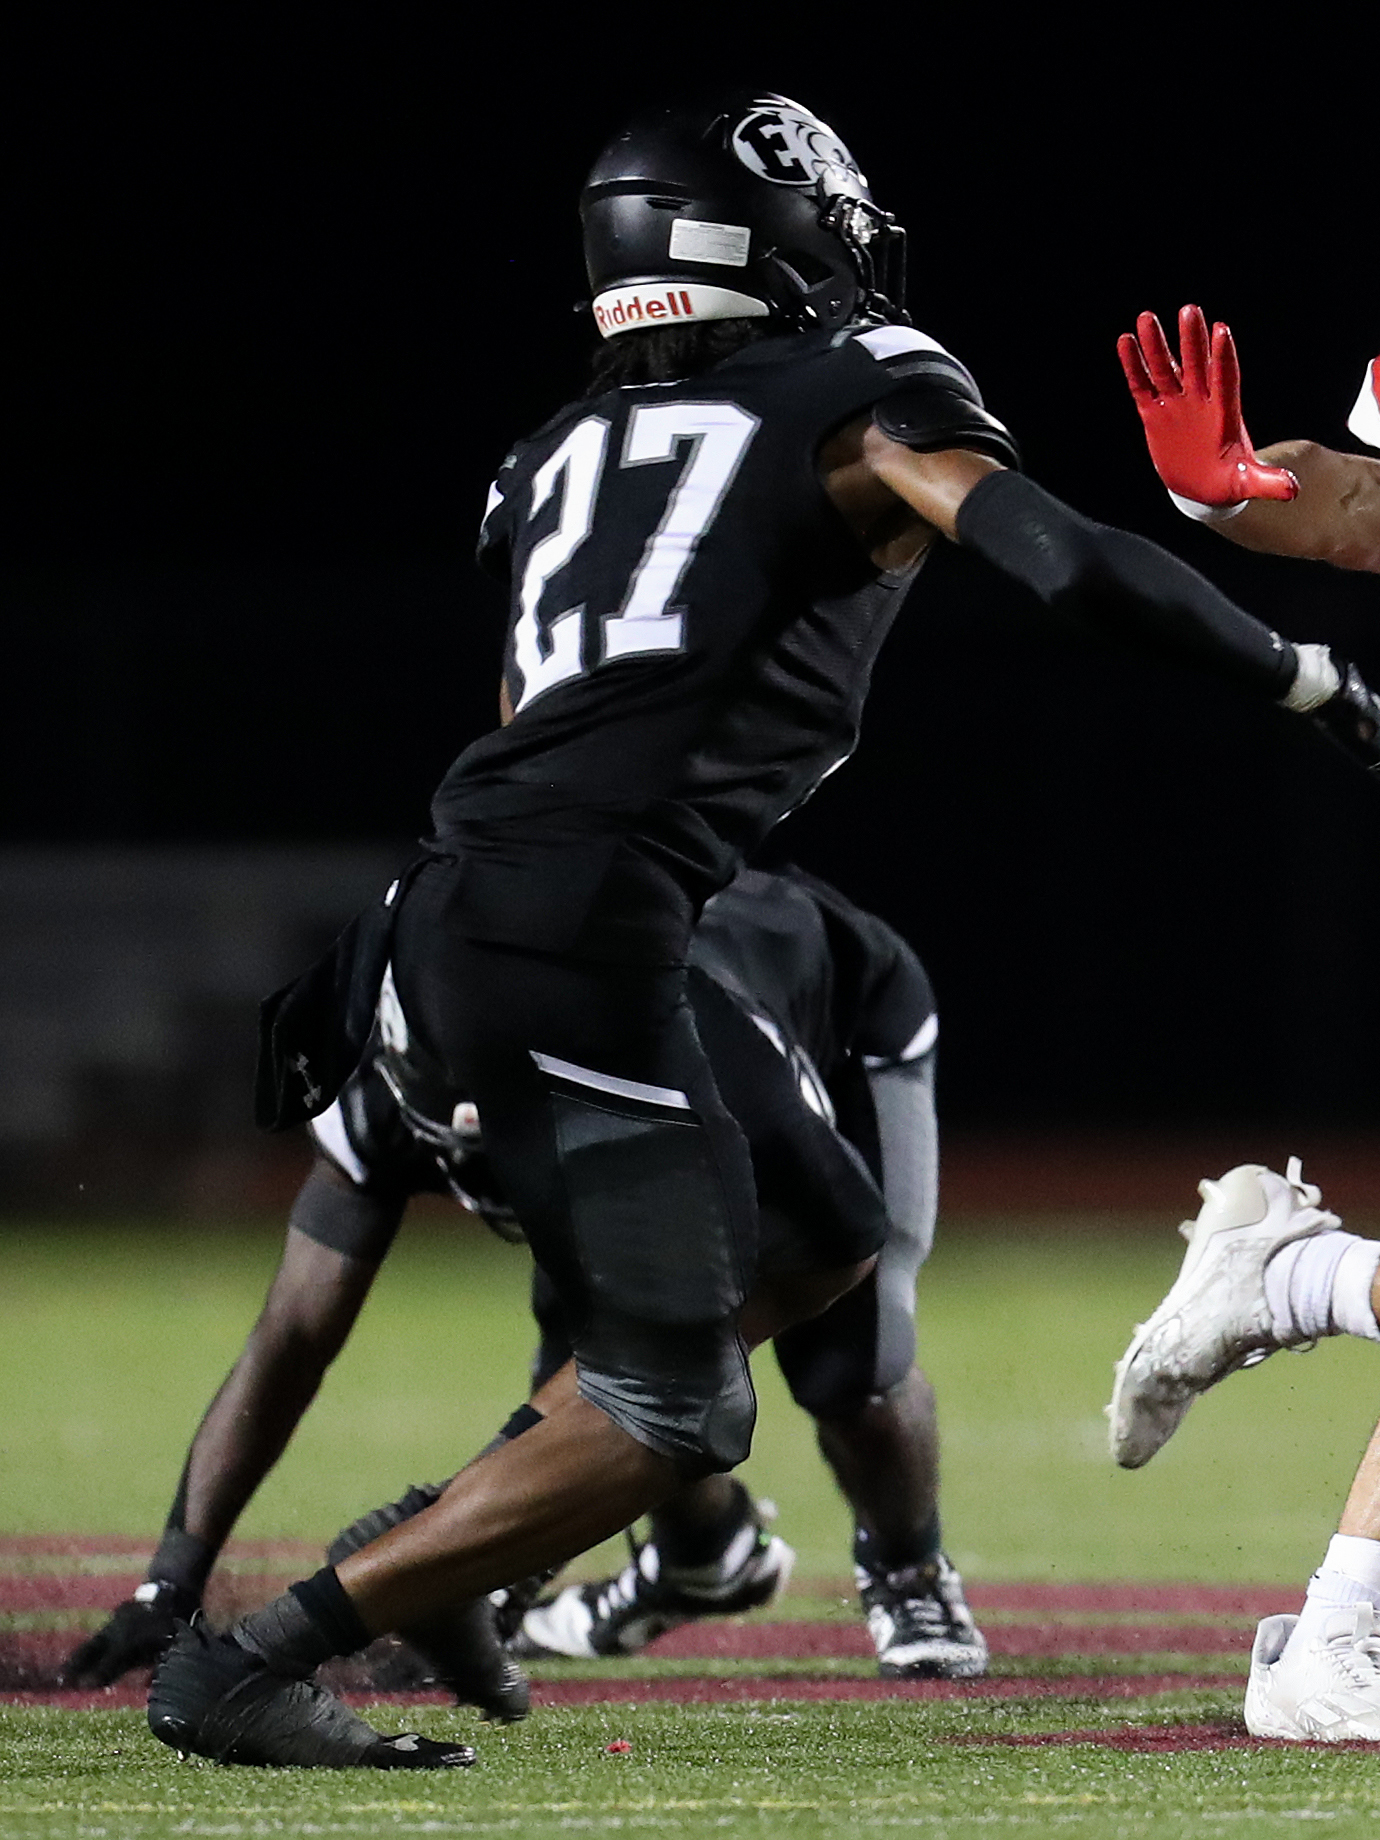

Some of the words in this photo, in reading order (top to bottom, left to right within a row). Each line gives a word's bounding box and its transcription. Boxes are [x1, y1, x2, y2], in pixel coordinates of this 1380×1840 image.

[737, 111, 812, 181] E
[594, 290, 693, 330] Riddell
[512, 400, 762, 714] 27
